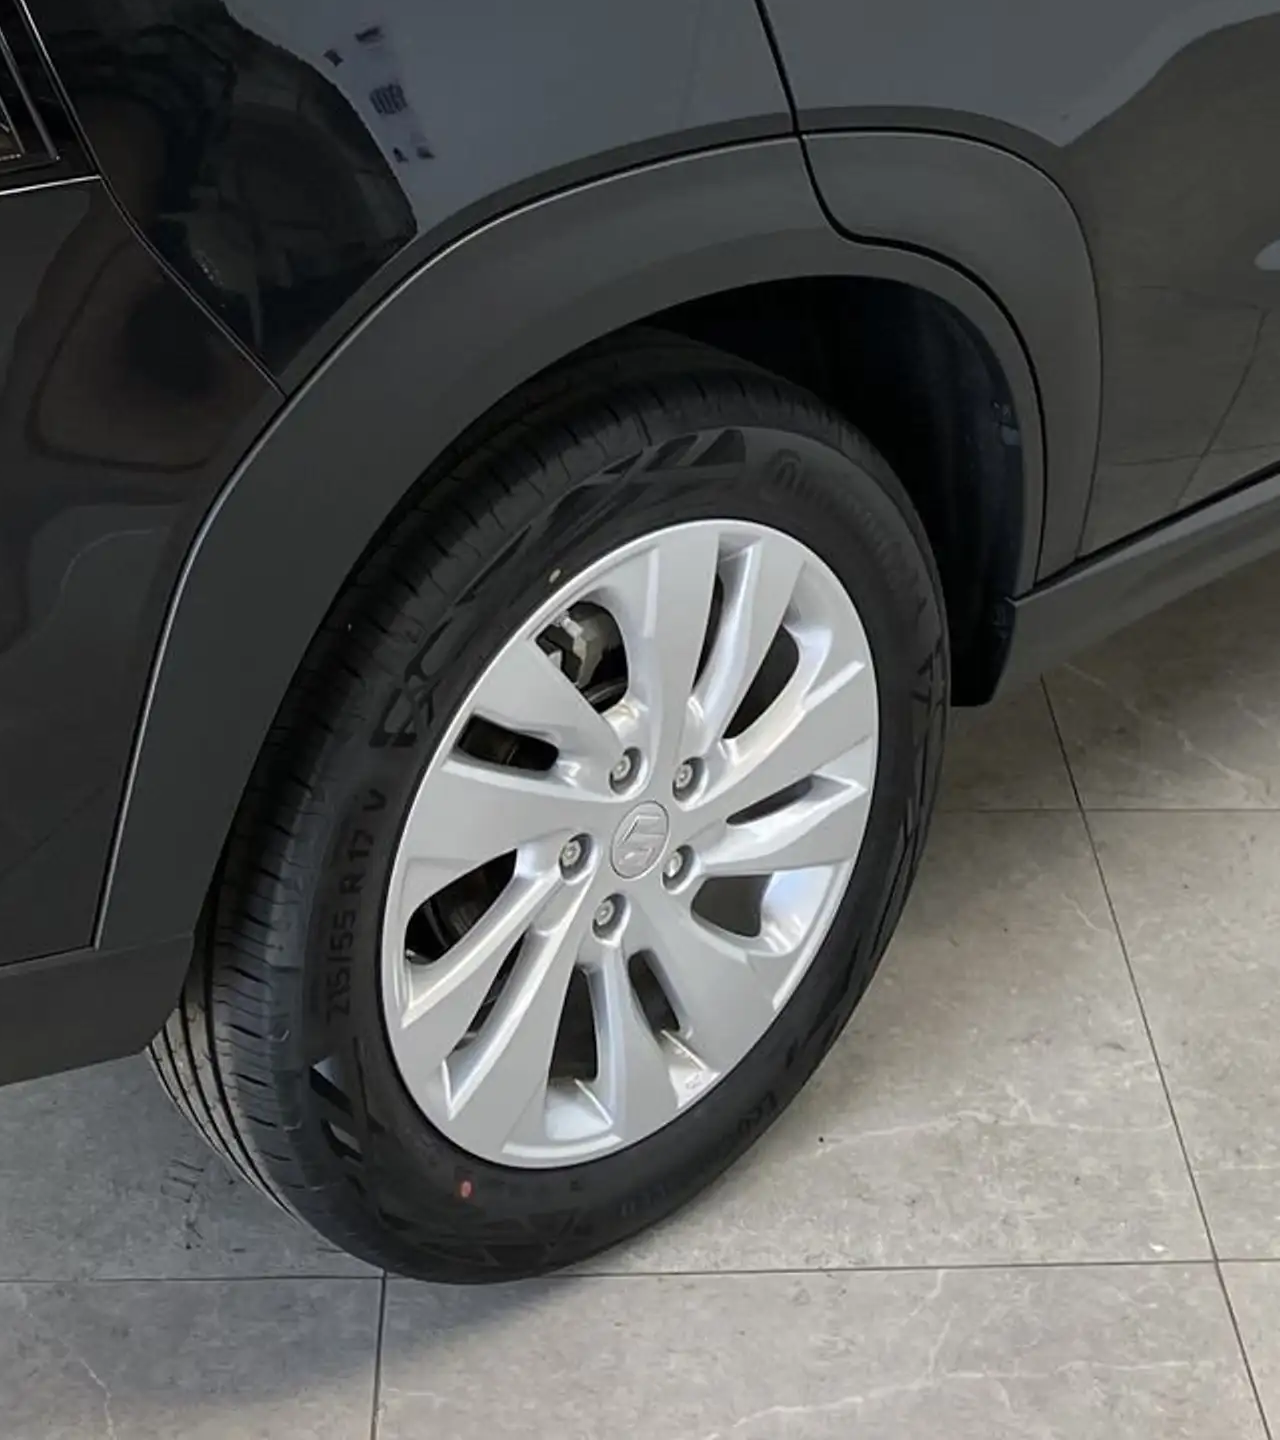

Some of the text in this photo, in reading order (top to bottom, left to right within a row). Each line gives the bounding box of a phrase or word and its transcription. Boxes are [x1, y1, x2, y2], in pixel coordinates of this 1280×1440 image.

[362, 787, 388, 813] V
[348, 829, 375, 862] 17
[338, 872, 366, 895] R
